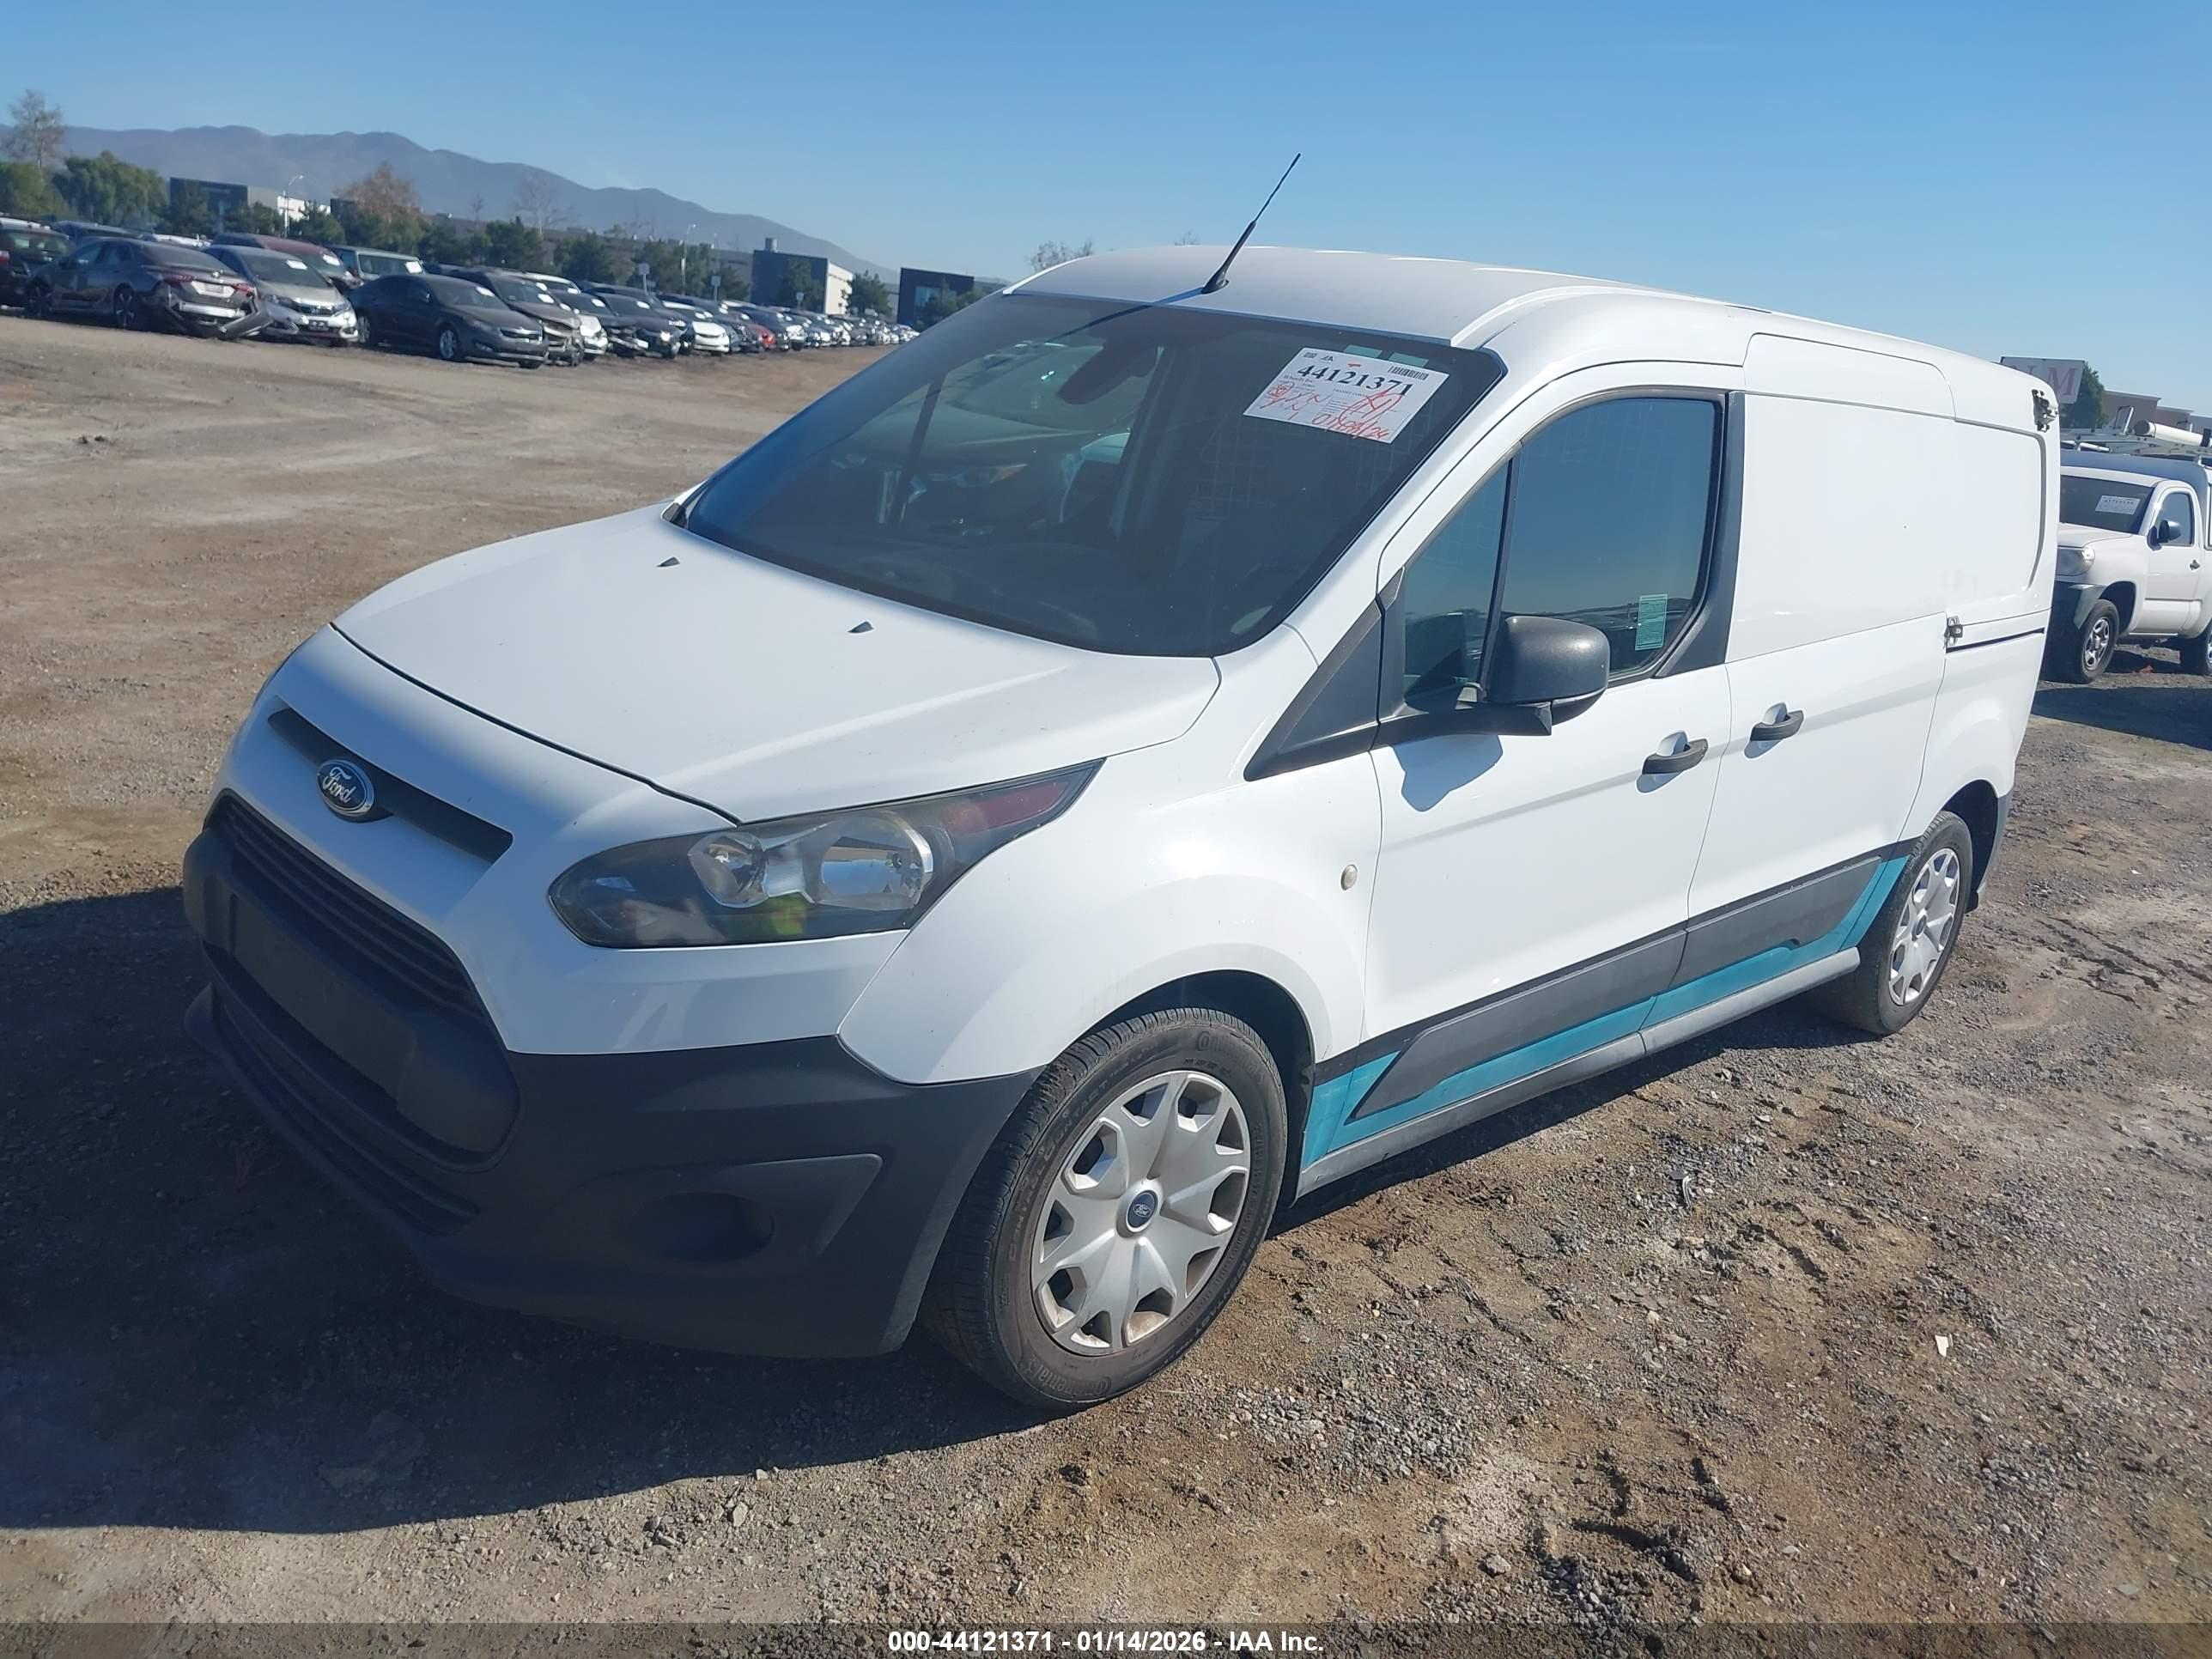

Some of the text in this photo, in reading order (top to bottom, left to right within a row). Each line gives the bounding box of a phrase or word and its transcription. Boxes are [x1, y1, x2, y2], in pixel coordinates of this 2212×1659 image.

[1297, 364, 1415, 396] 44121371
[322, 766, 357, 804] Ford
[1134, 1204, 1150, 1216] Ford
